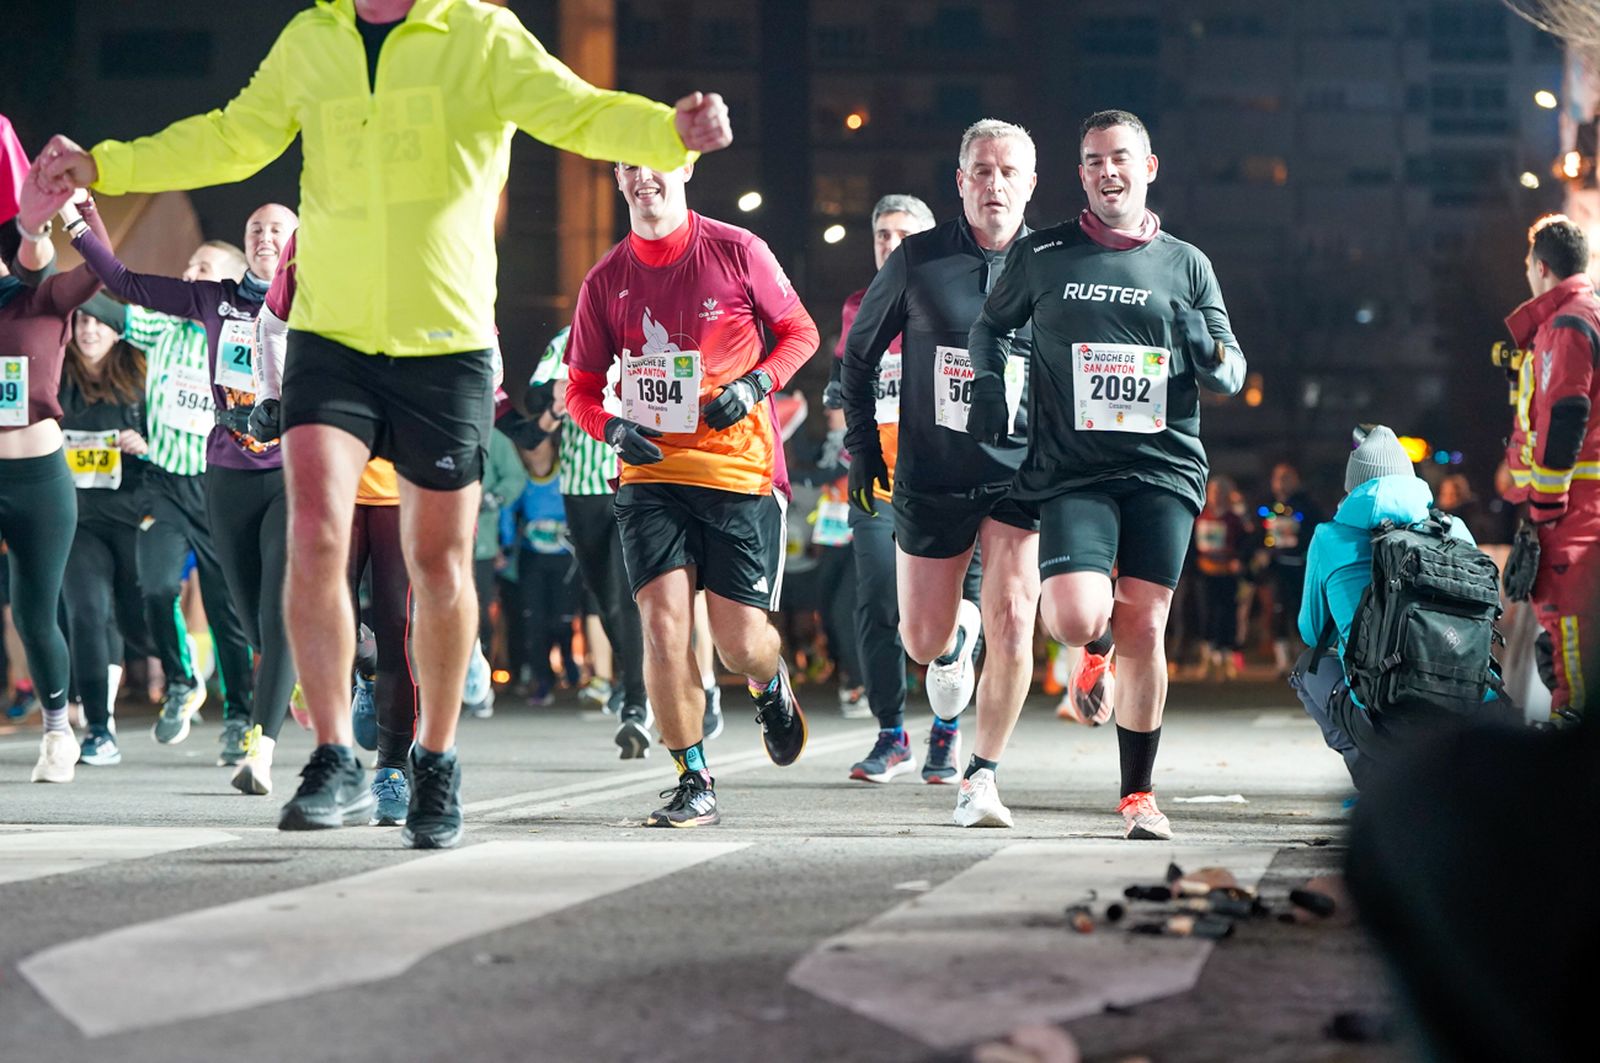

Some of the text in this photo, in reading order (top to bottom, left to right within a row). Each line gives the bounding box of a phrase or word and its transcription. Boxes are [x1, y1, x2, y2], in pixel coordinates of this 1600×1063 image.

[1063, 283, 1149, 306] RUSTER
[1094, 353, 1135, 363] NOCHE DE
[943, 366, 960, 377] SAN
[1083, 364, 1101, 373] SAN
[1104, 363, 1135, 374] ANTÓN
[637, 378, 683, 404] 1394
[1090, 375, 1151, 403] 2092
